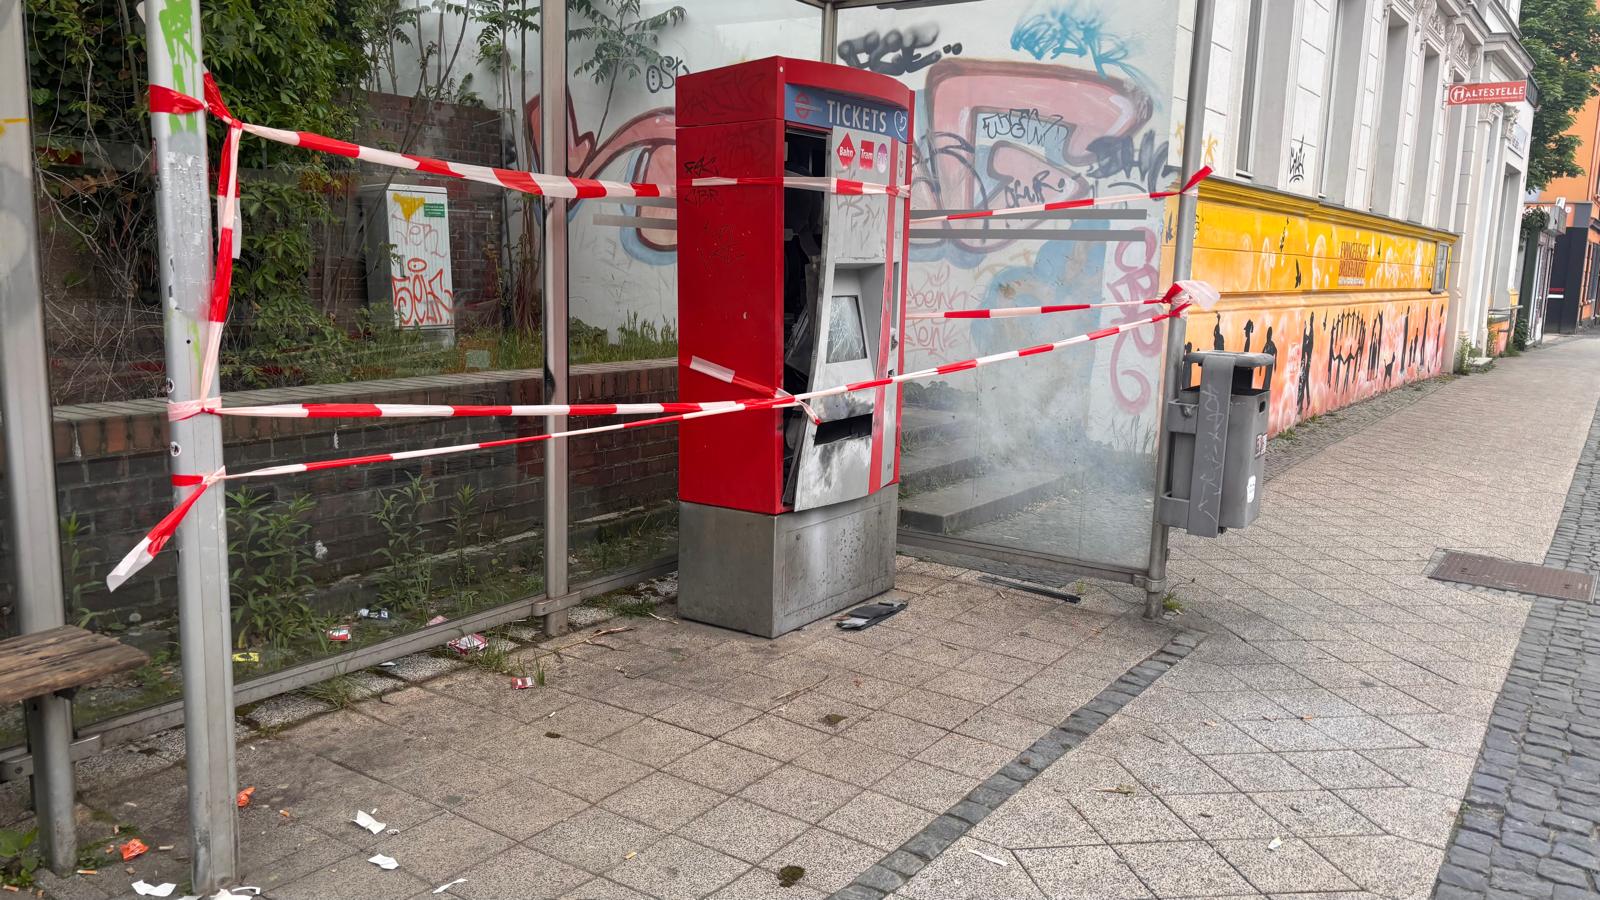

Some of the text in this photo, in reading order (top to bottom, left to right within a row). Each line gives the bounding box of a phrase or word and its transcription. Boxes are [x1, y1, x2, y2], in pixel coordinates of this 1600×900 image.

[1453, 86, 1525, 102] HALTESTELLE
[826, 99, 887, 133] TICKETS
[839, 146, 854, 157] Bahn
[861, 149, 873, 160] Tram
